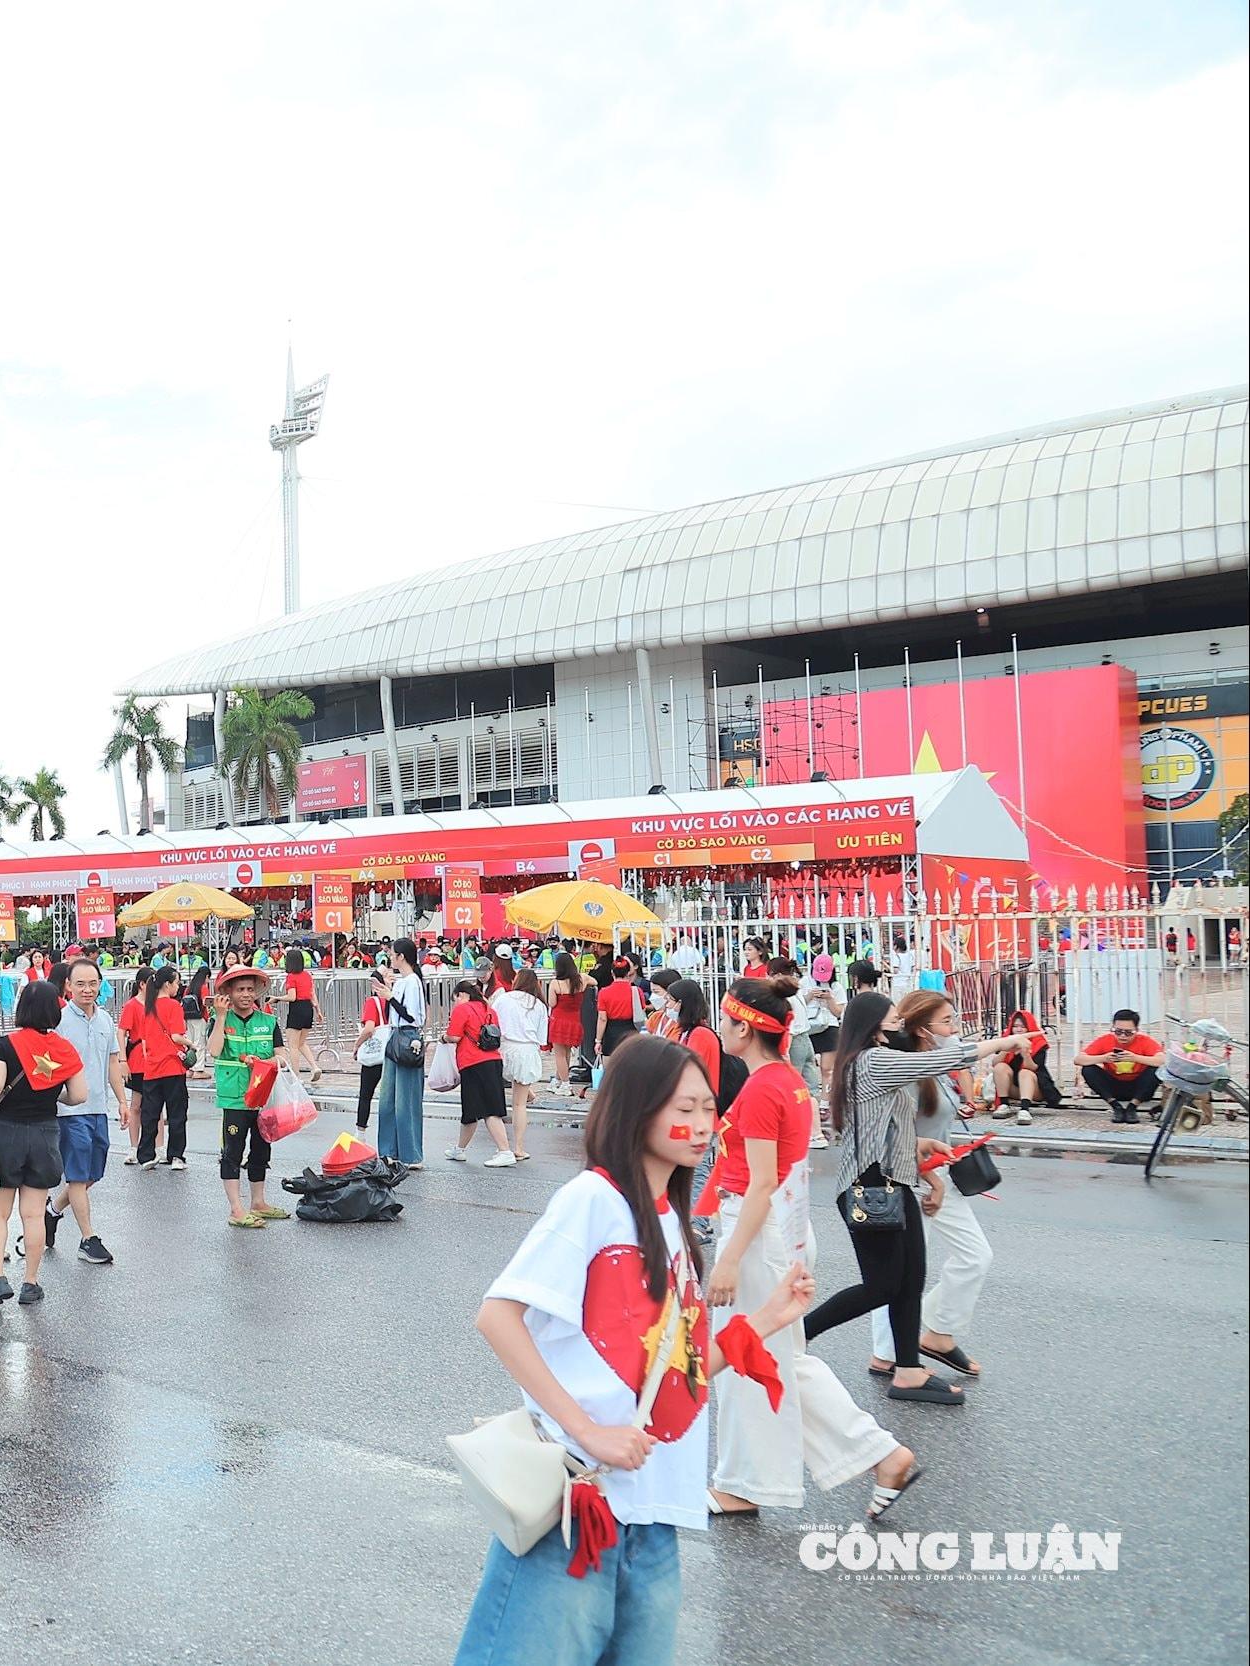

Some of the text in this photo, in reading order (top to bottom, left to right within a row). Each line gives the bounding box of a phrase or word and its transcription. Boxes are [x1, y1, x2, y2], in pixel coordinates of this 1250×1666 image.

[631, 800, 911, 834] KHU VỰC LỐI VÀO CÁC HẠNG VÉ
[656, 833, 766, 850] CỜ ĐỎ SAO VÀNG
[836, 832, 903, 848] ƯU TIÊN
[160, 841, 337, 865] KHU VỰC LỐI VÀO CÁC HẠNG VÉ
[362, 852, 446, 867] CỜ ĐỎ SAO VÀNG
[653, 854, 671, 865] C1
[750, 848, 772, 861] C2
[516, 862, 536, 872] B4
[288, 874, 303, 884] A2
[358, 869, 375, 880] A4
[318, 895, 332, 903] SAO
[448, 890, 461, 898] SAO
[325, 912, 342, 927] C1
[454, 907, 472, 924] C2
[88, 920, 105, 934] B2
[578, 929, 603, 940] CSGT
